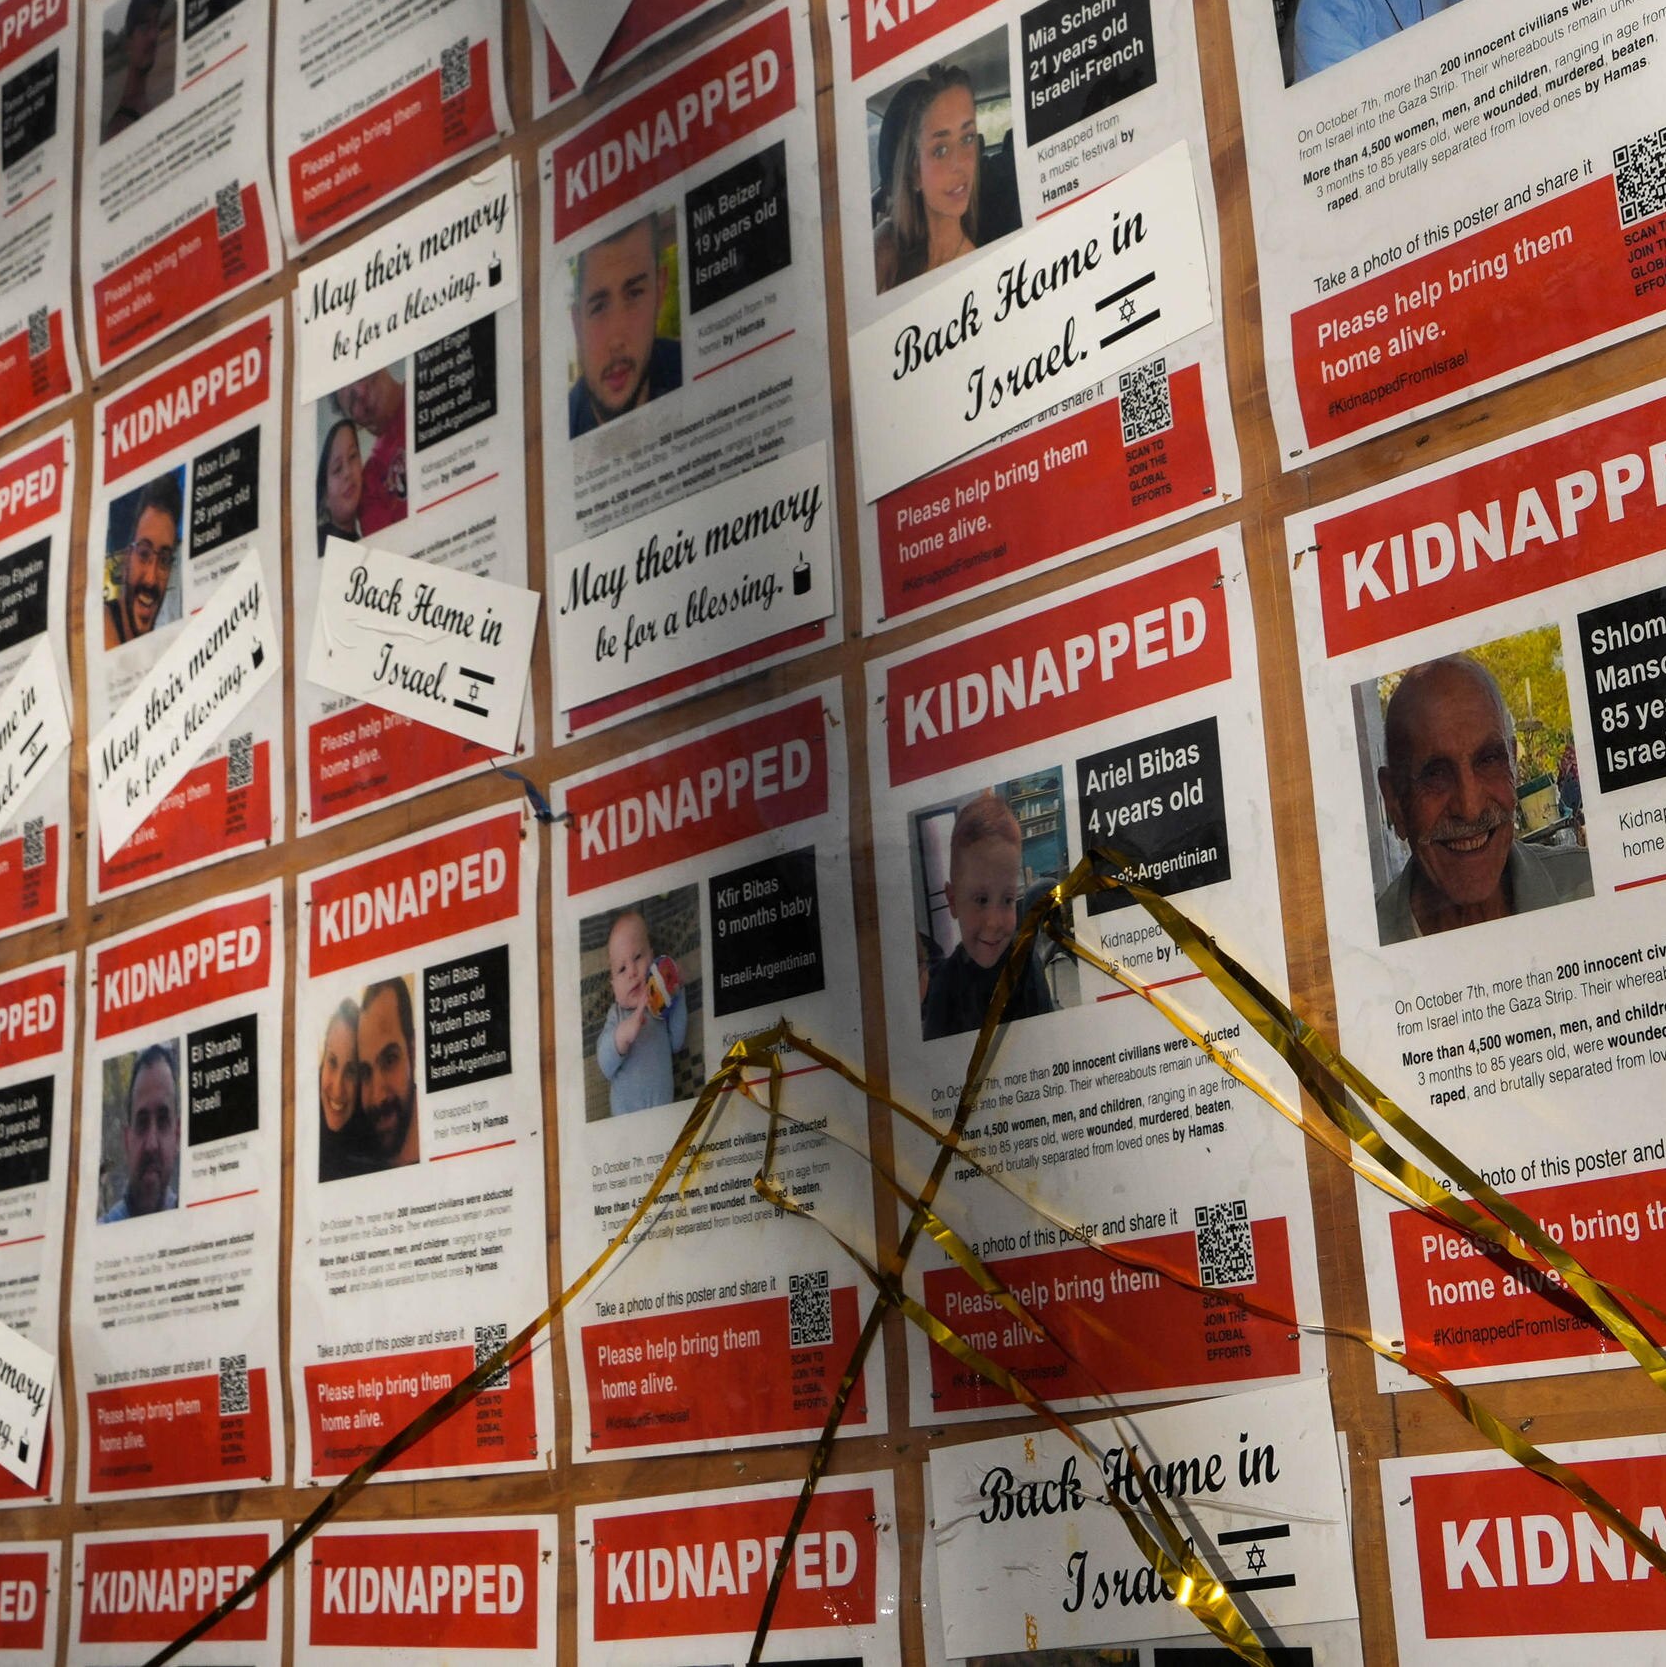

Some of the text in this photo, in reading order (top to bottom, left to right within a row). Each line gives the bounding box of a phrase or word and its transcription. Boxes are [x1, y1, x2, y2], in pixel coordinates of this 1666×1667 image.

[1028, 26, 1057, 53] Mia
[1029, 11, 1128, 82] 21 years old
[1031, 37, 1144, 110] Israeli-French
[565, 48, 780, 209] KIDNAPPED
[304, 193, 508, 325] May their memory
[1623, 224, 1657, 247] SCAN
[1627, 242, 1655, 264] JOIN
[332, 270, 482, 362] be for a blessing.
[892, 211, 1148, 381] Back Home in
[112, 347, 262, 458] KIDNAPPED
[964, 315, 1088, 422] Israel.
[560, 484, 823, 615] May their memory
[595, 570, 784, 664] be for a blessing.
[904, 596, 1207, 746] KIDNAPPED
[1600, 701, 1630, 733] 85
[579, 738, 811, 861] KIDNAPPED
[1085, 744, 1200, 797] Ariel Bibas
[1088, 777, 1204, 837] 4 years old
[1622, 836, 1665, 858] home
[319, 847, 507, 947] KIDNAPPED
[716, 877, 780, 910] Kfir Bibas
[717, 896, 813, 938] 9 months baby
[103, 925, 262, 1013] KIDNAPPED
[720, 951, 817, 989] Israeli-Argentinian
[322, 1564, 524, 1614] KIDNAPPED
